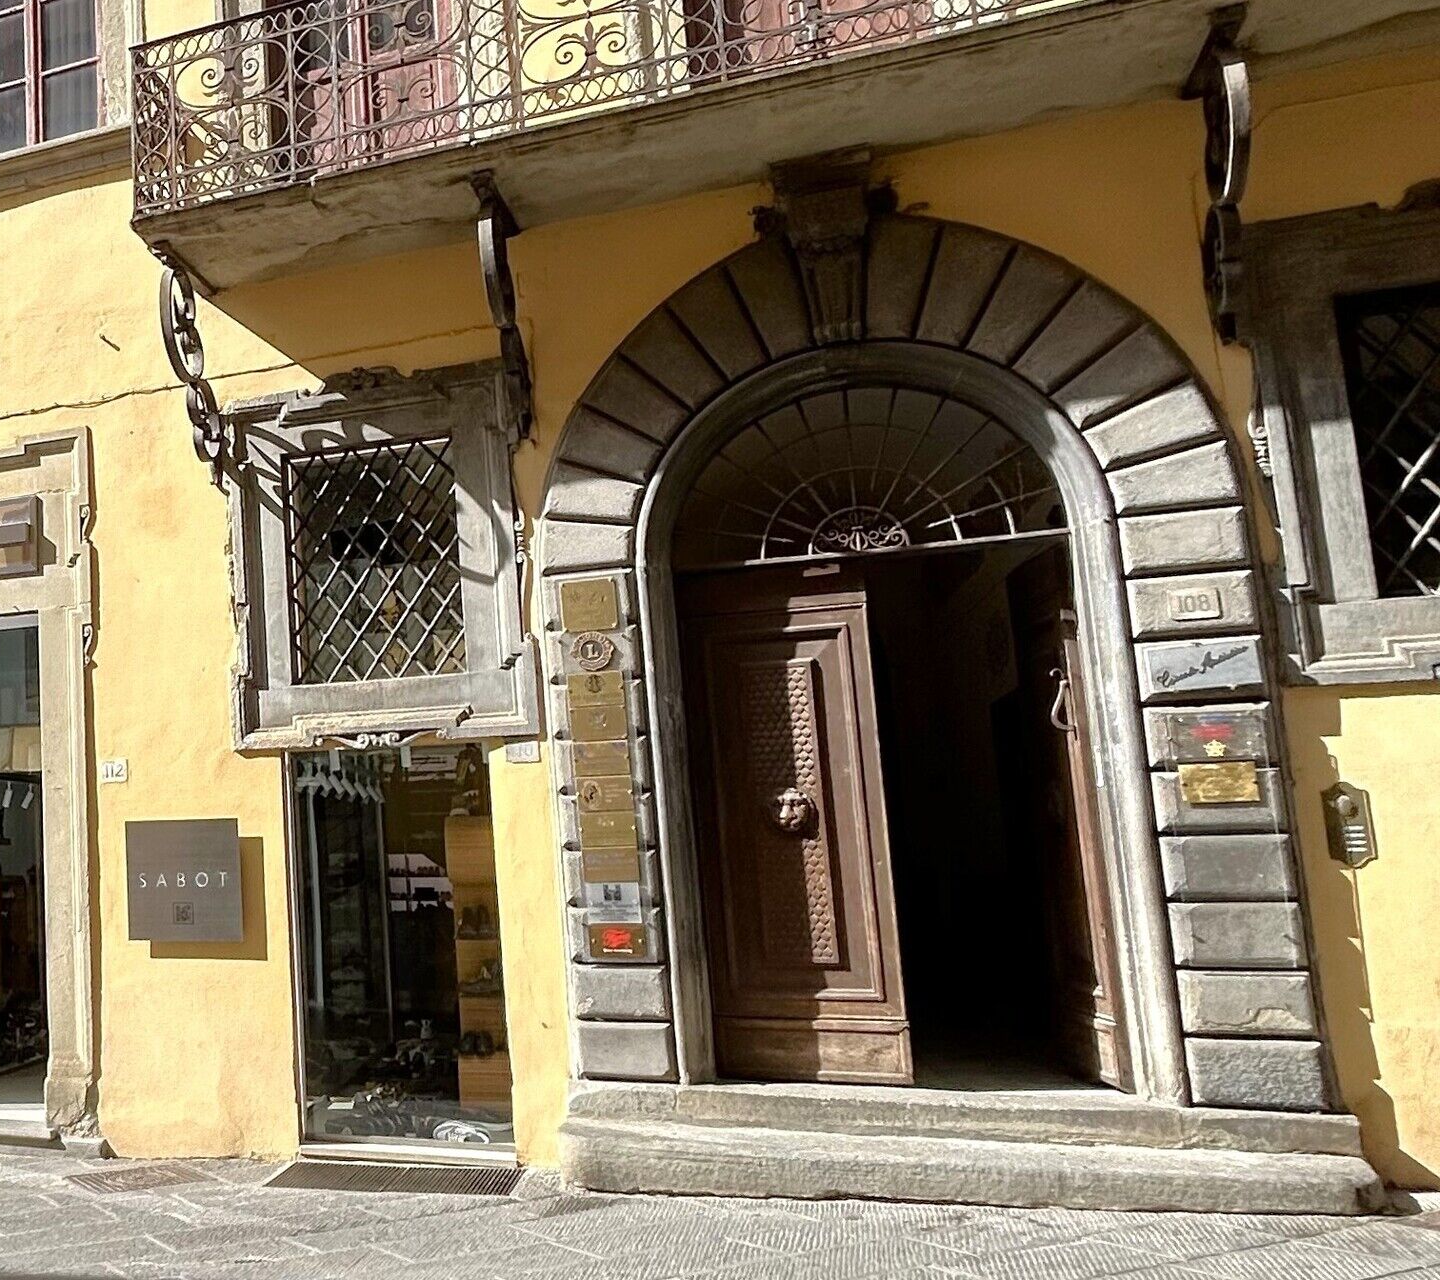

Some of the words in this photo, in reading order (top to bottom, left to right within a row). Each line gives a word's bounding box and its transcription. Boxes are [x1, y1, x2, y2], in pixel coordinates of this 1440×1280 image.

[1176, 593, 1211, 613] 108
[105, 763, 124, 778] 112
[138, 871, 228, 889] SABOT
